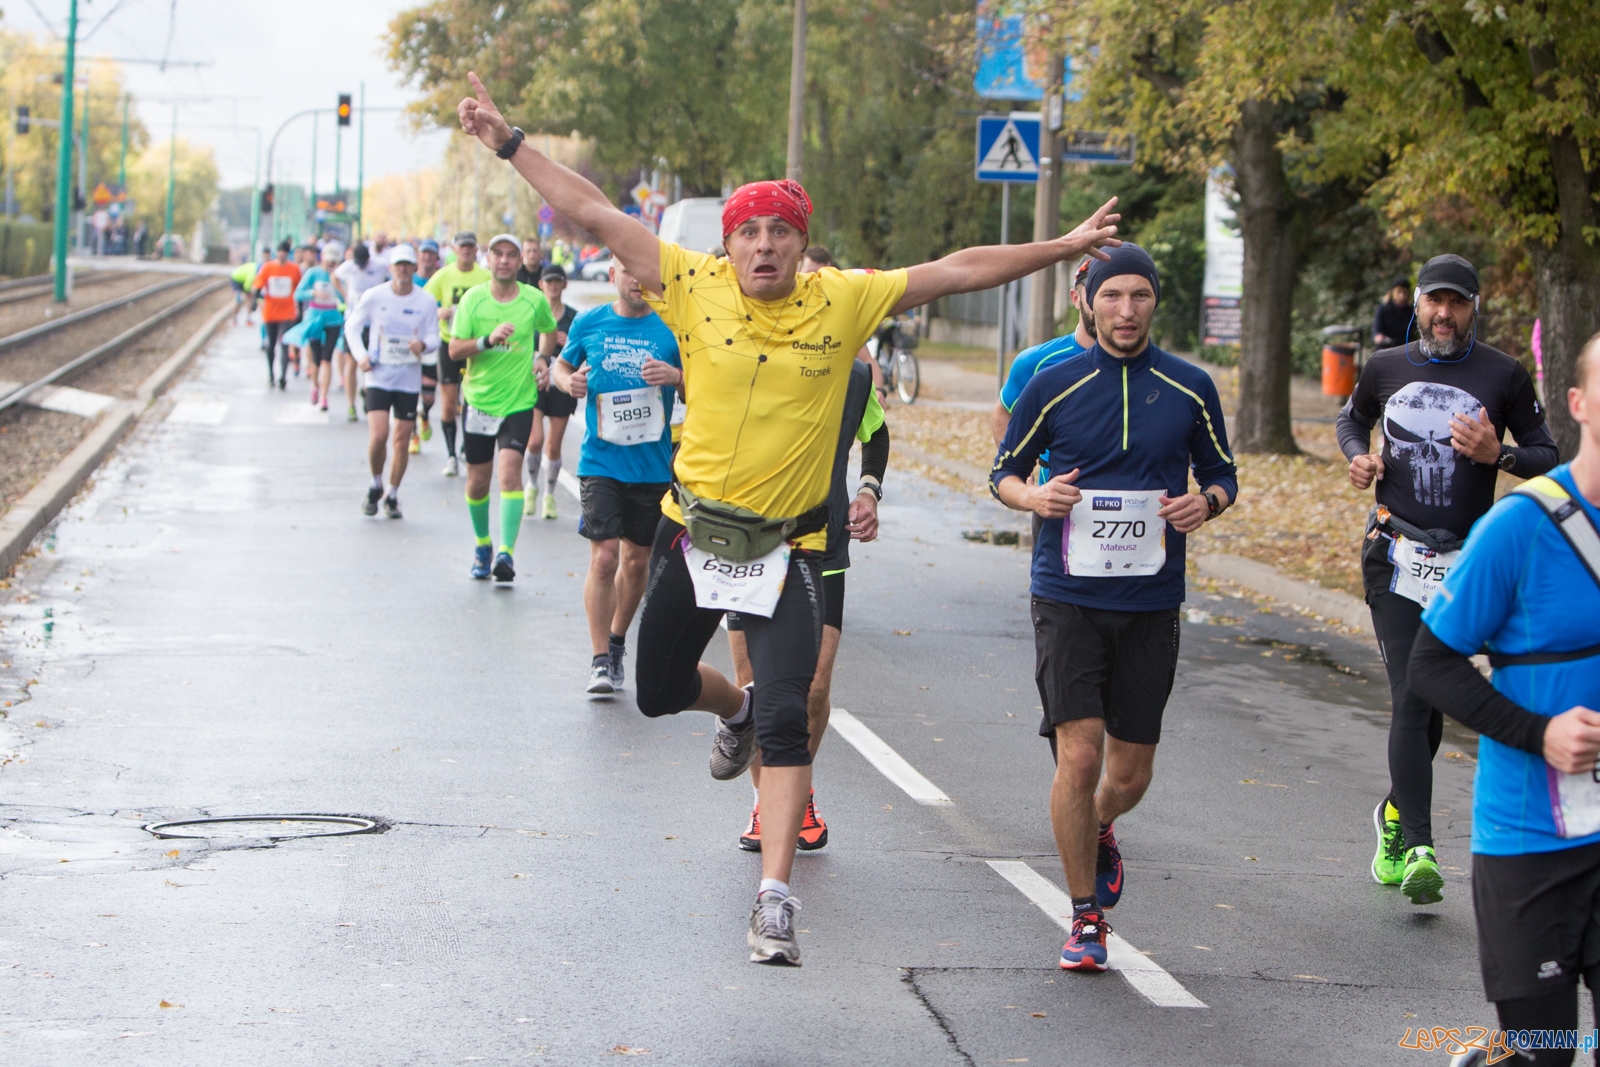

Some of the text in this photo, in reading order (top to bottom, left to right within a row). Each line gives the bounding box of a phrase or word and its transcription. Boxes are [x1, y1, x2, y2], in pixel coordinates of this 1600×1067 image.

[799, 365, 832, 377] Tomek
[613, 406, 652, 423] 5893
[1092, 520, 1146, 539] 2770
[1100, 543, 1138, 551] Mateusz
[1411, 562, 1450, 581] 375
[711, 574, 748, 588] Tomasz
